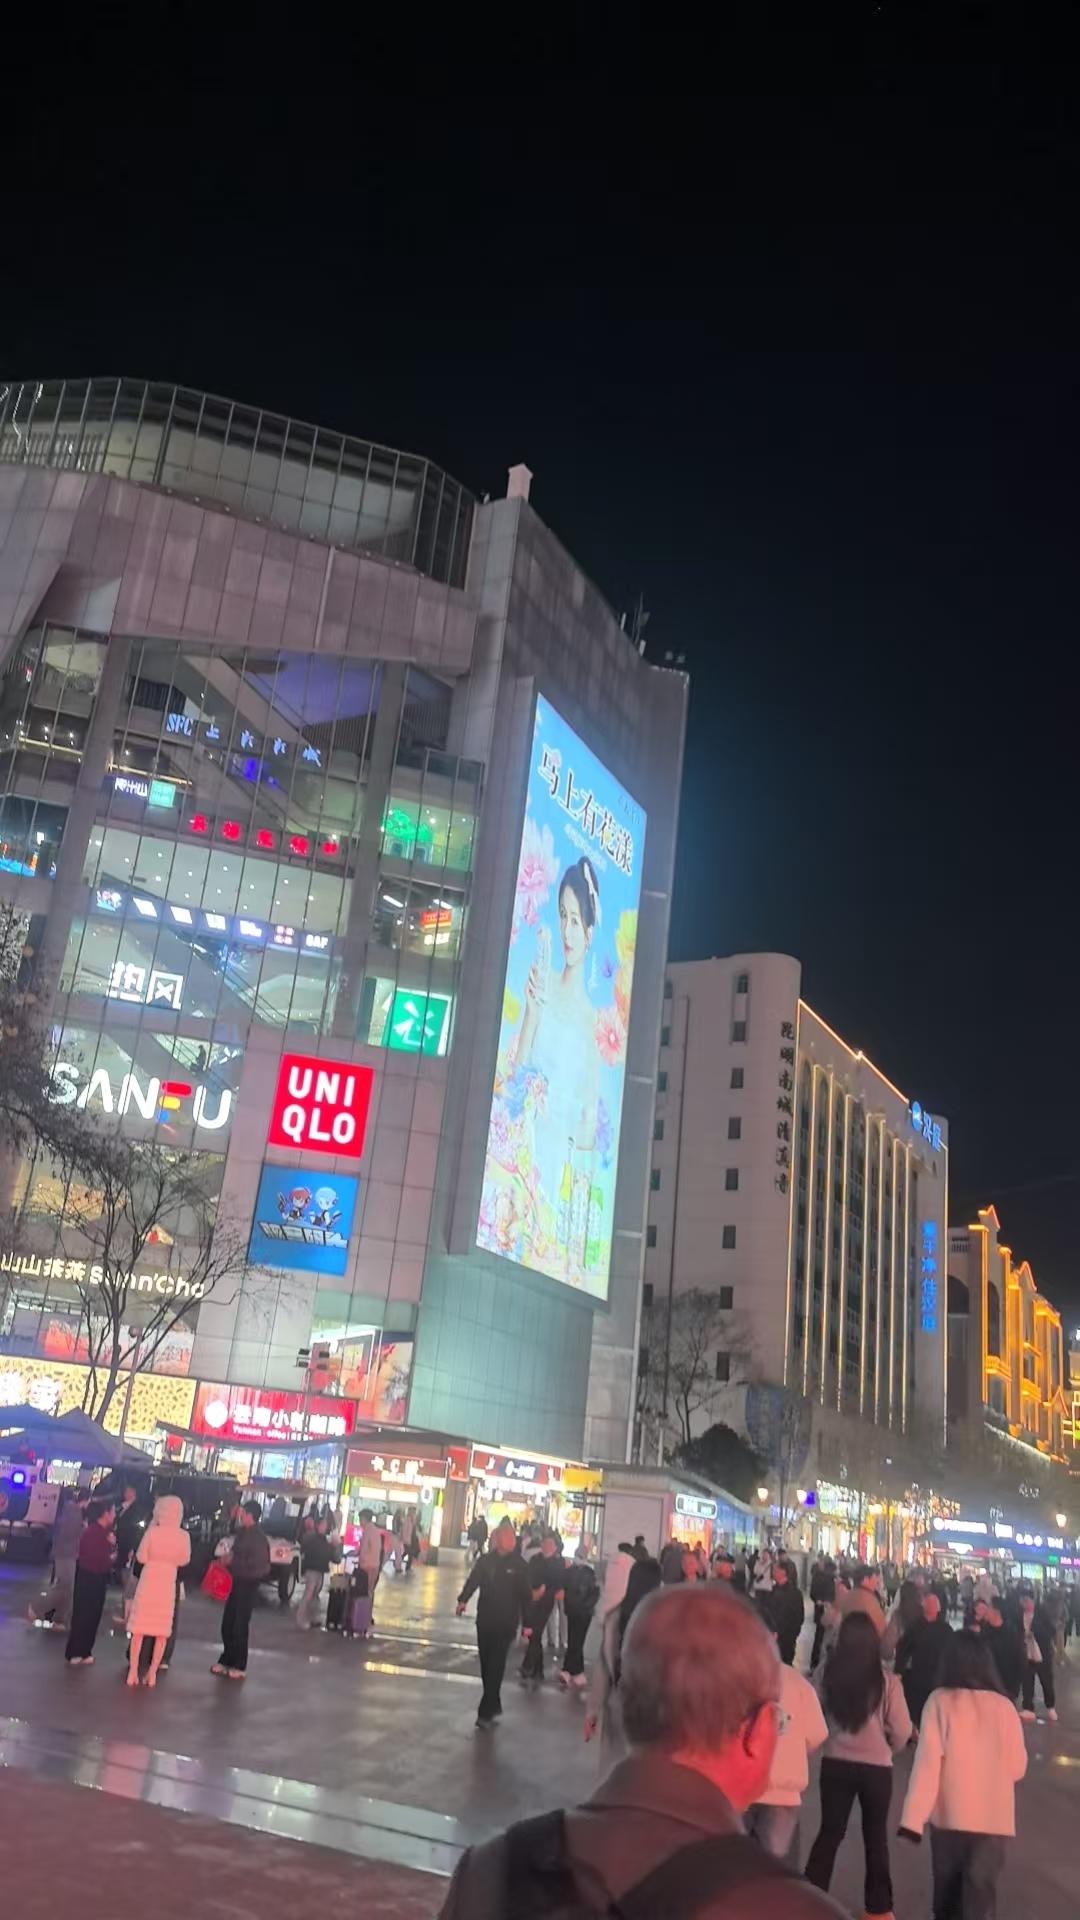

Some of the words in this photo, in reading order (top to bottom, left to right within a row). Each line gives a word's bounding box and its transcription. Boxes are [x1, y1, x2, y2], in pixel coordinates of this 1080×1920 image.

[166, 713, 193, 736] SFC
[46, 1062, 232, 1130] SANFU
[286, 1065, 356, 1106] UNI
[281, 1103, 356, 1145] QLO
